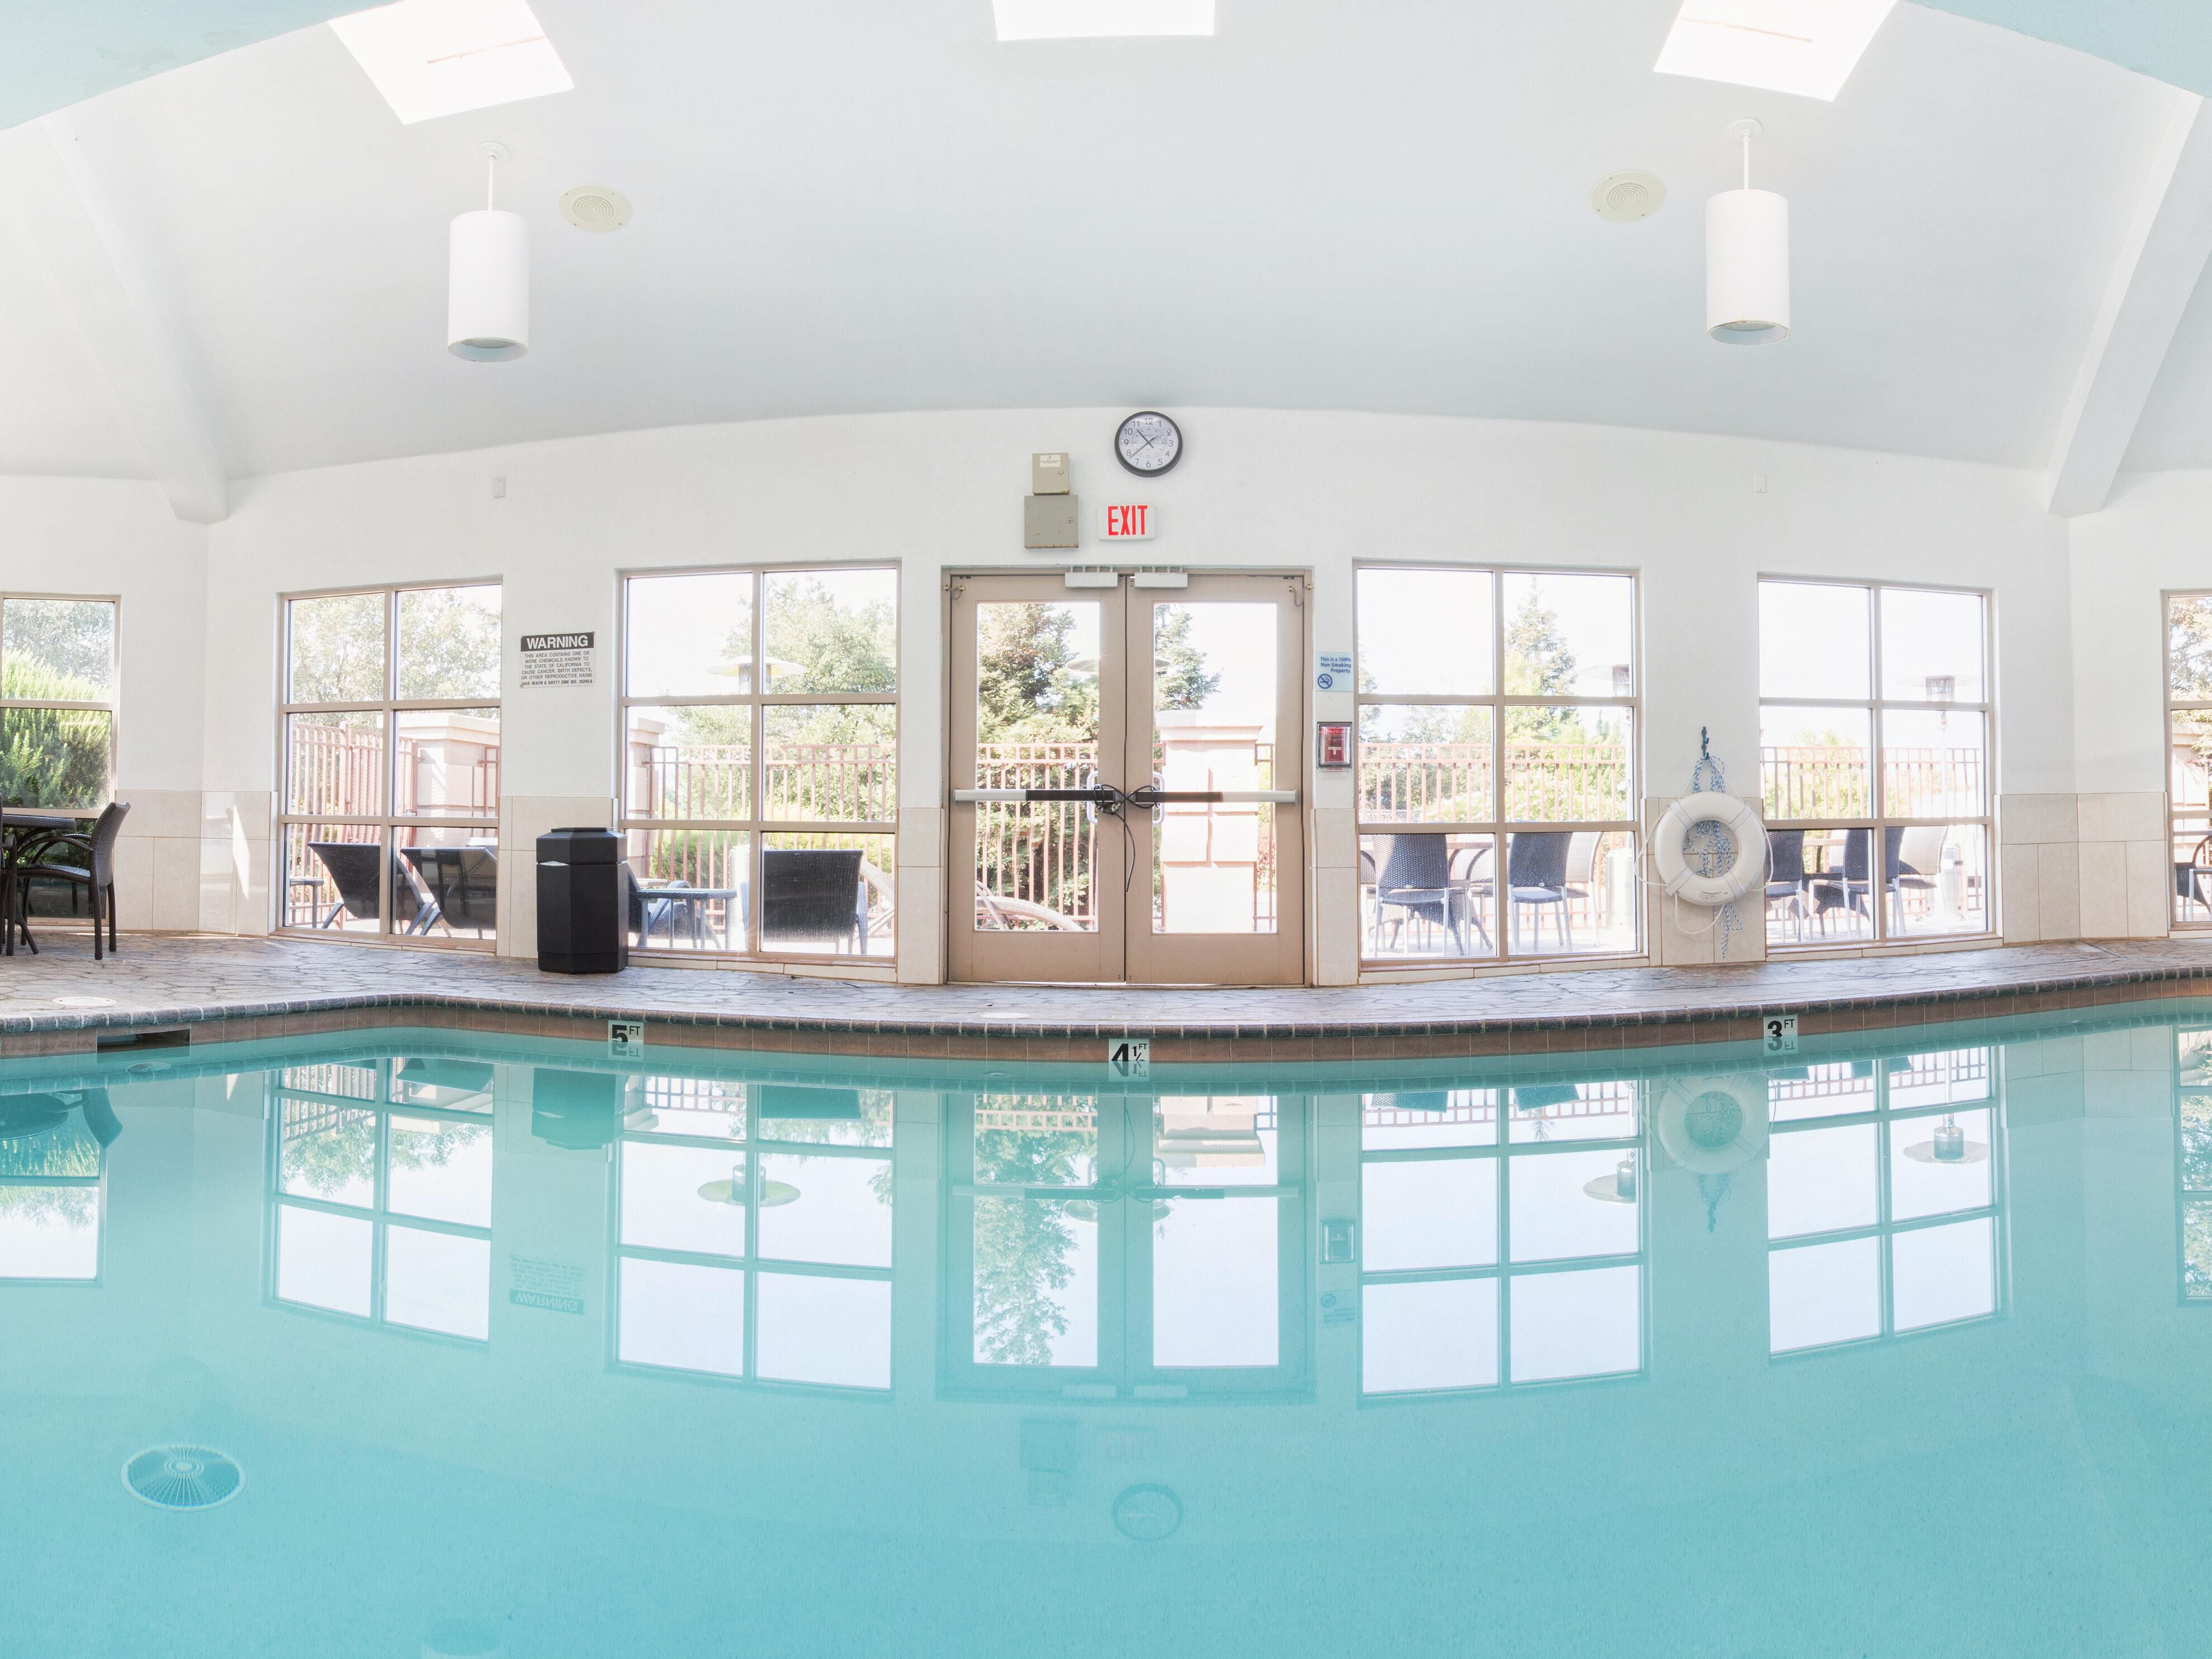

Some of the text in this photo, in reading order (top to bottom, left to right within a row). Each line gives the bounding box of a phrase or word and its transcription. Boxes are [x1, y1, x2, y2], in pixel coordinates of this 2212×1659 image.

[1108, 505, 1147, 535] EXIT
[526, 635, 588, 649] WARNING
[612, 1024, 641, 1042] 5 FT
[1768, 1019, 1795, 1037] 3 FT
